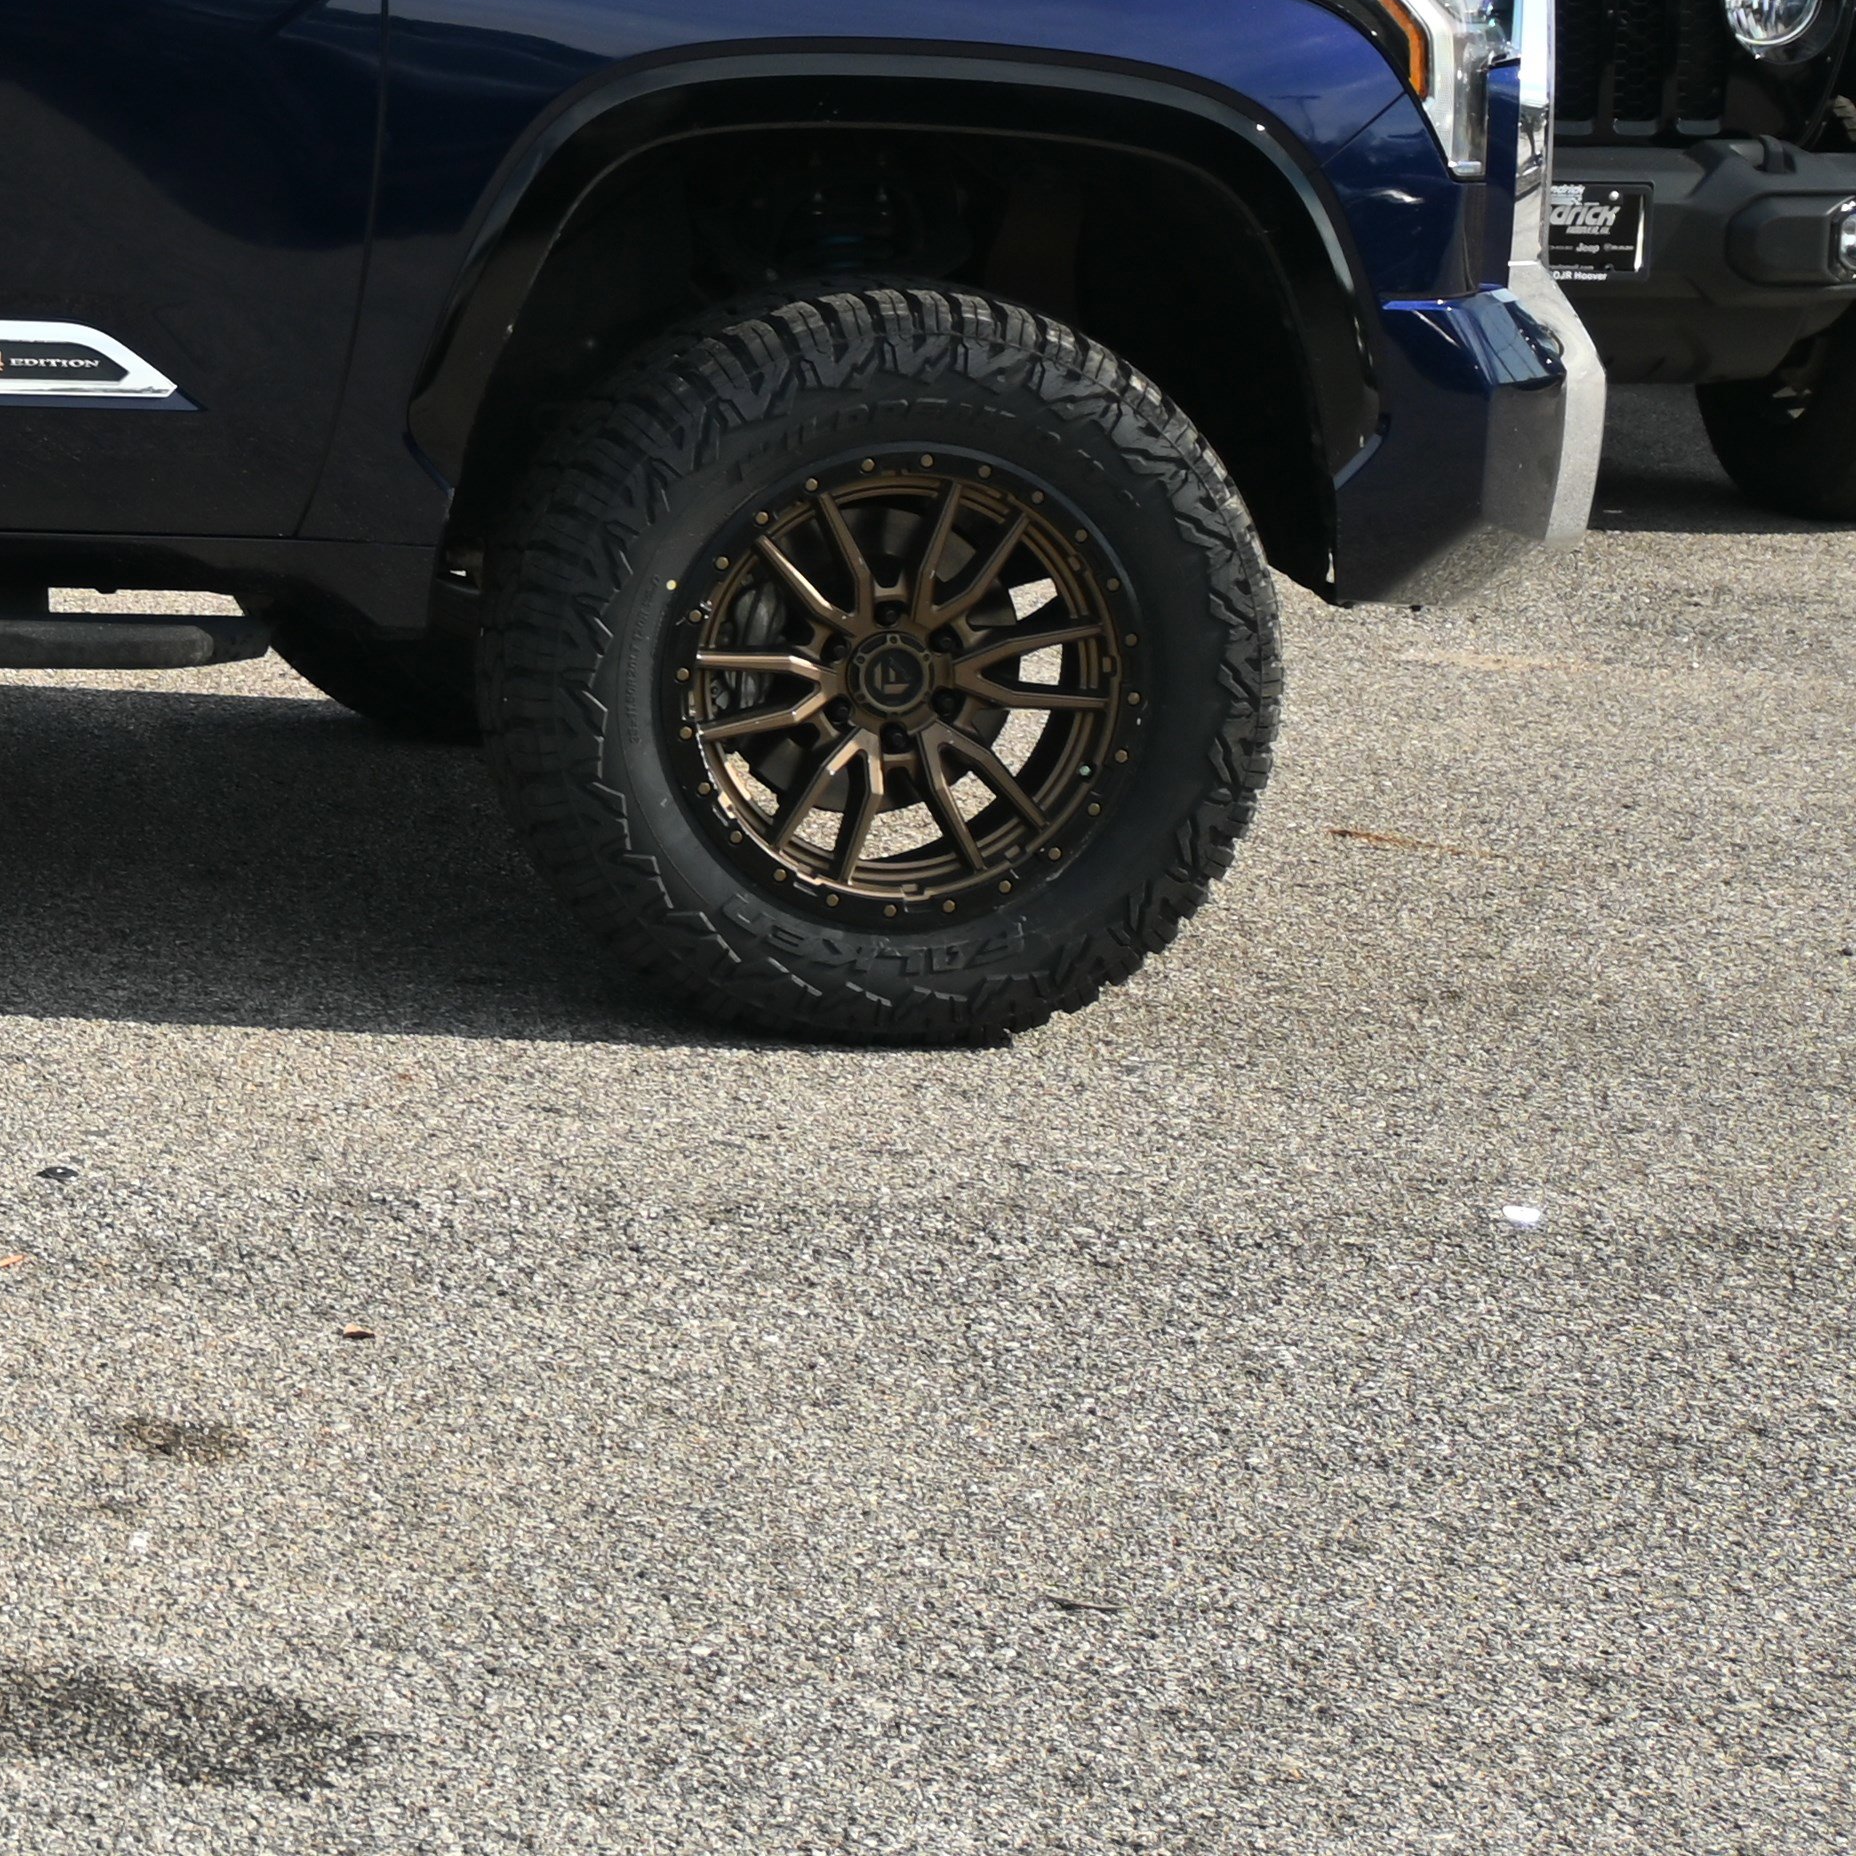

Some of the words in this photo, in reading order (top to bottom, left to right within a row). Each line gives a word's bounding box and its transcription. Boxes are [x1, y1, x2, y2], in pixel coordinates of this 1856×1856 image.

[1550, 205, 1621, 226] drick
[1576, 243, 1600, 254] Jeep
[1551, 270, 1572, 280] DJR
[1574, 272, 1607, 281] Hoover
[9, 358, 100, 369] EDITION
